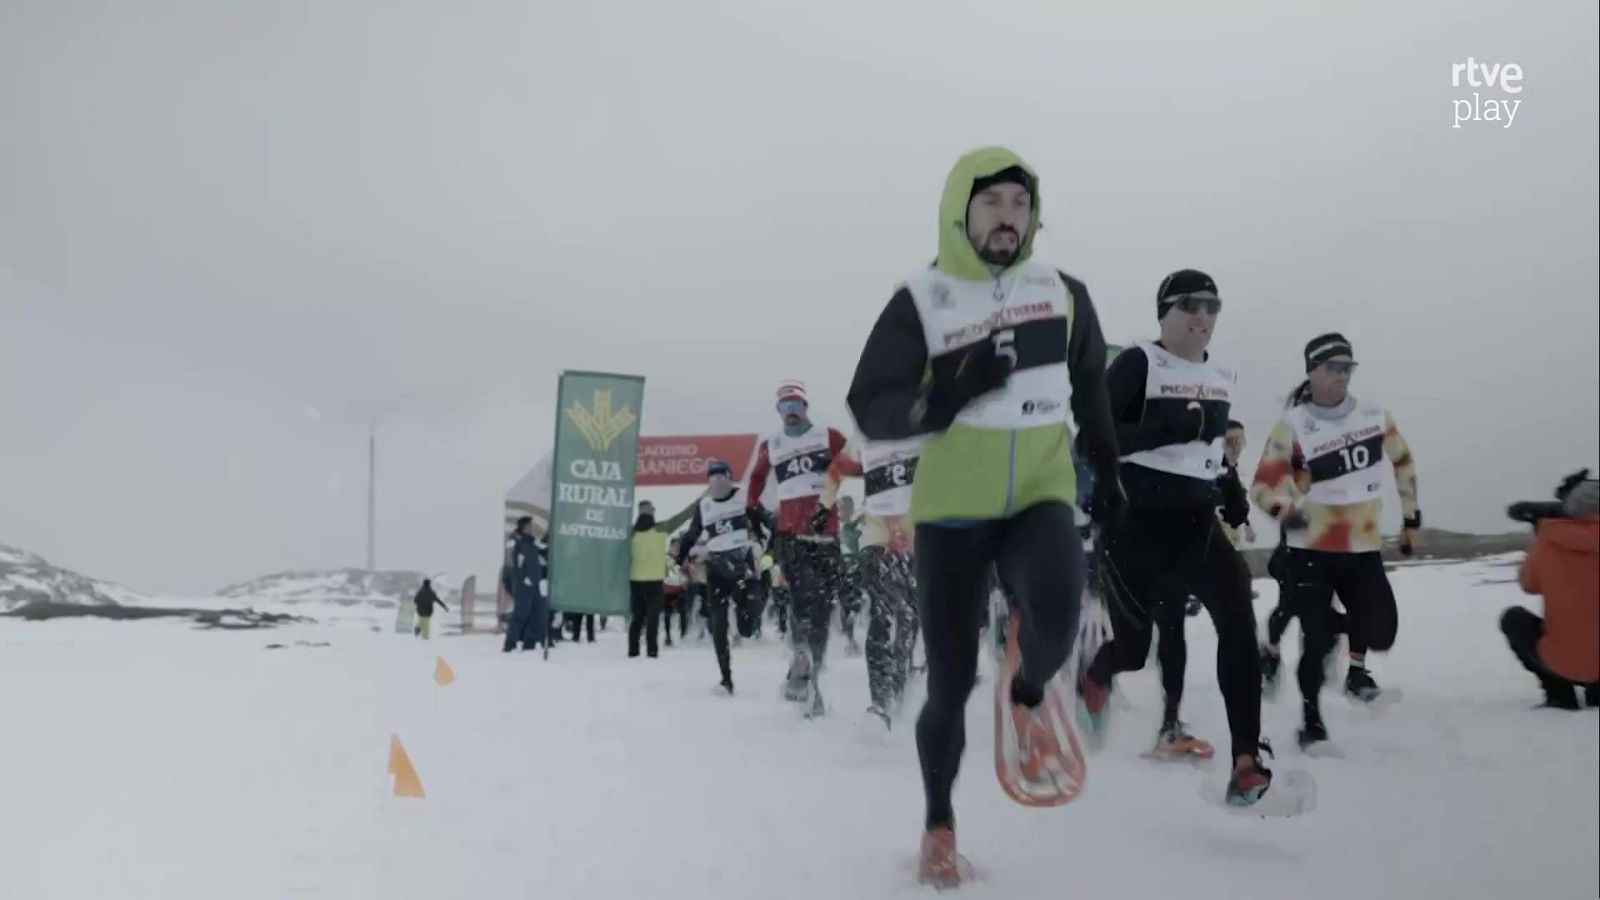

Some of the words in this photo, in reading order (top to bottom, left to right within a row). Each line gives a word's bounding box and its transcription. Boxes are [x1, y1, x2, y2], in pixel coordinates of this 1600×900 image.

[570, 459, 622, 481] CAJA
[787, 453, 812, 474] 40
[1339, 447, 1369, 472] 10
[558, 481, 632, 508] RURAL
[586, 509, 604, 522] DE
